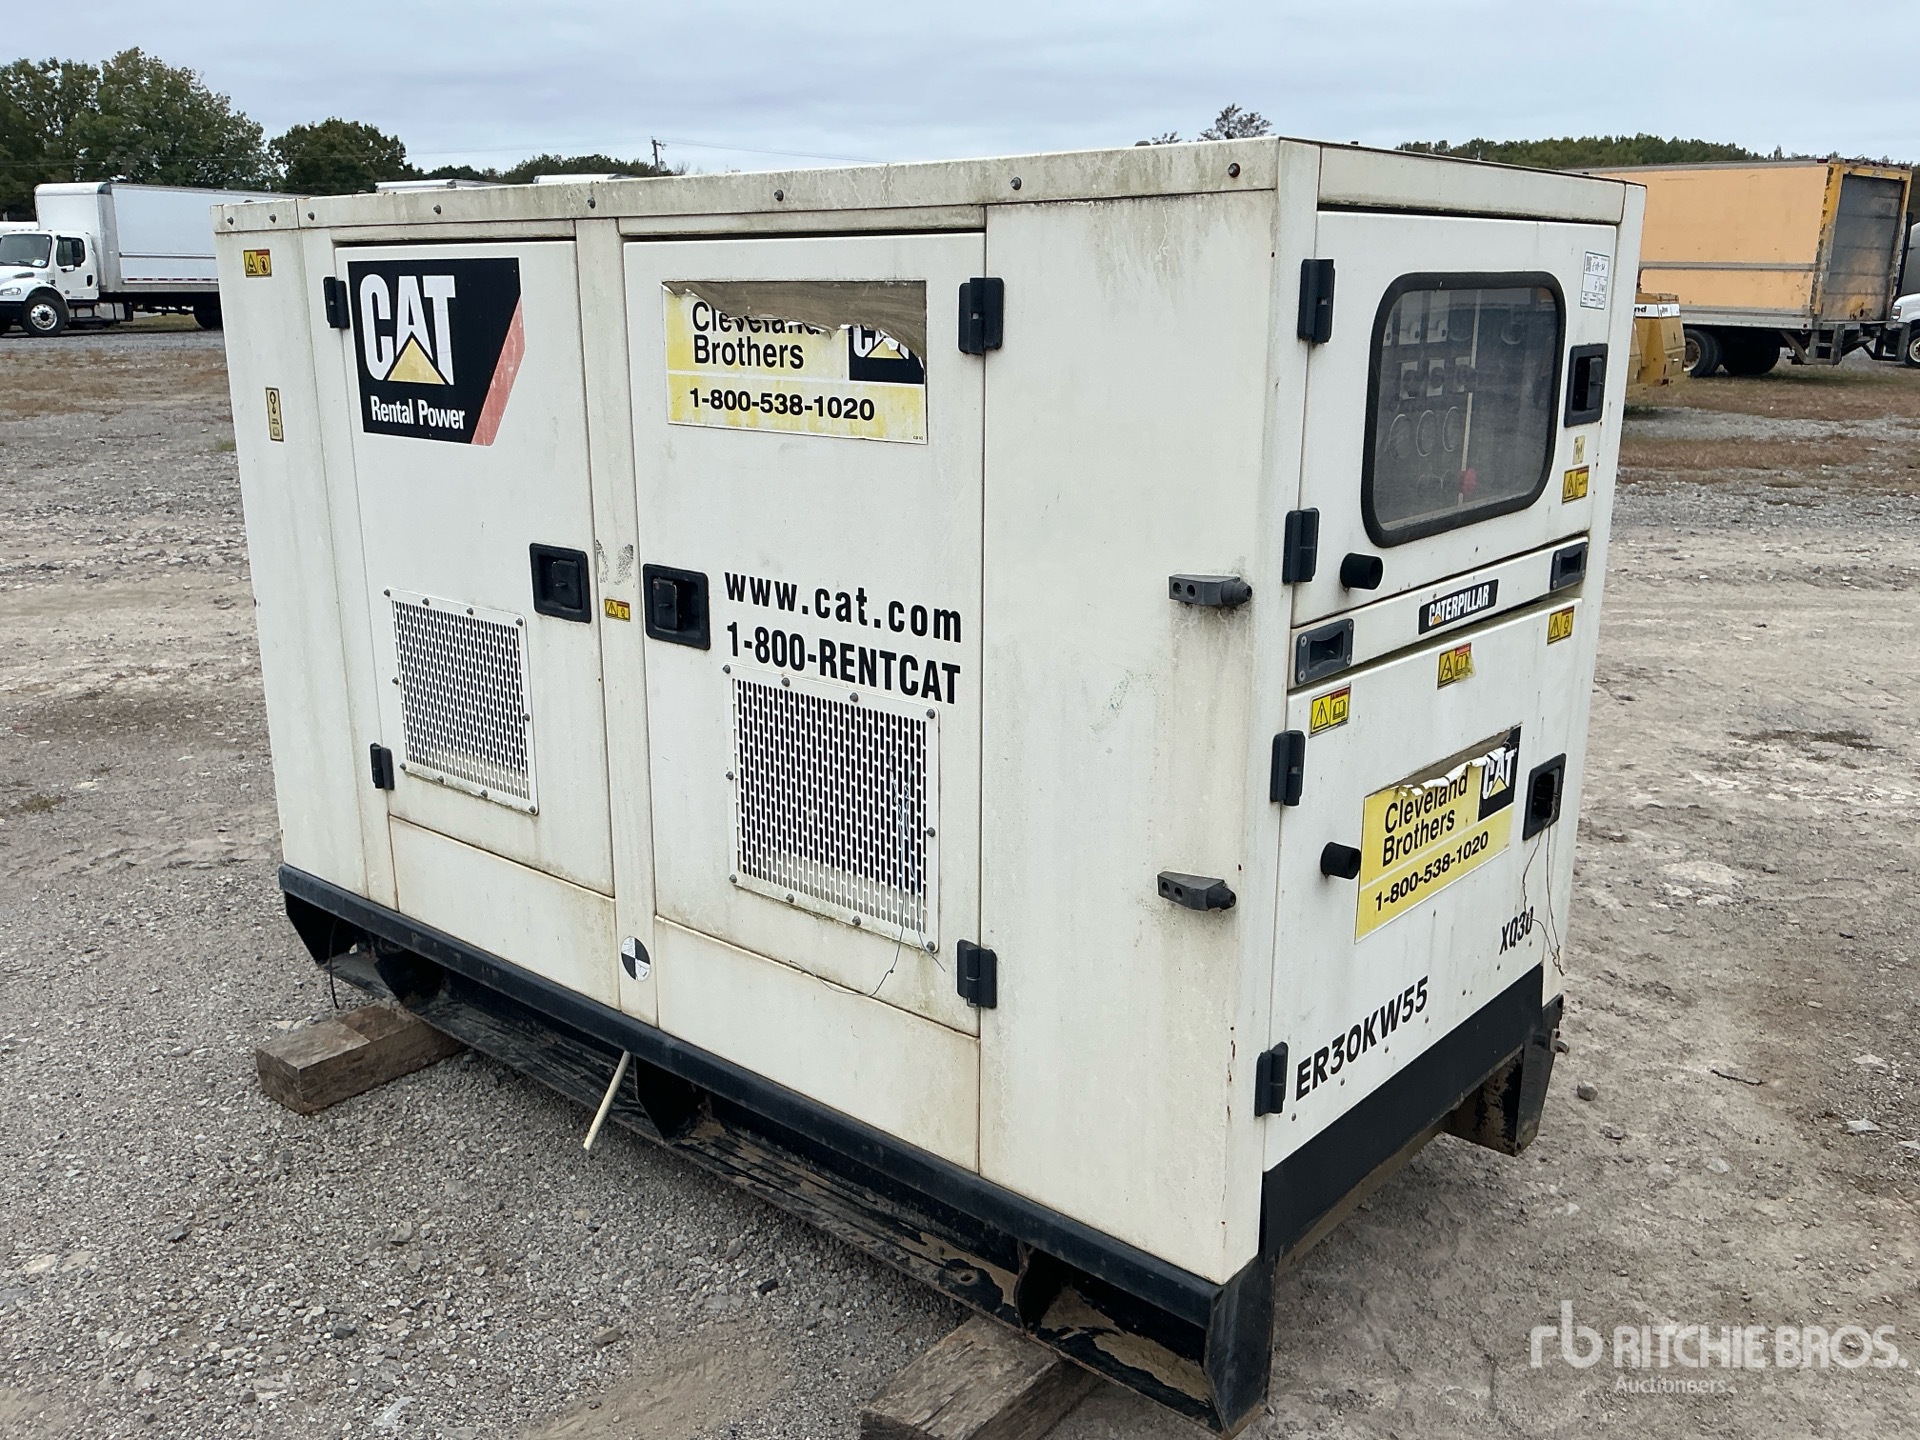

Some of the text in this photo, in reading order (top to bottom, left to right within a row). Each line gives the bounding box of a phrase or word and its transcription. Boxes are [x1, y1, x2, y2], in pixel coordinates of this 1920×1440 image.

[360, 274, 456, 386] CAT
[692, 301, 821, 335] Clevea
[693, 334, 804, 370] Brothers
[370, 395, 465, 430] Rental Power
[690, 387, 875, 421] 1-800-538-1020
[724, 571, 961, 643] www.cat.com
[1428, 584, 1490, 627] CATERPILLAR
[727, 621, 961, 705] 1-800-RENTCAT
[1482, 747, 1515, 800] CAT
[1385, 769, 1468, 834] Cleveland
[1383, 809, 1455, 867] Brothers
[1375, 830, 1489, 911] 1-800-538-1020
[1499, 905, 1534, 955] XQ30
[1296, 975, 1428, 1101] ER30KW55
